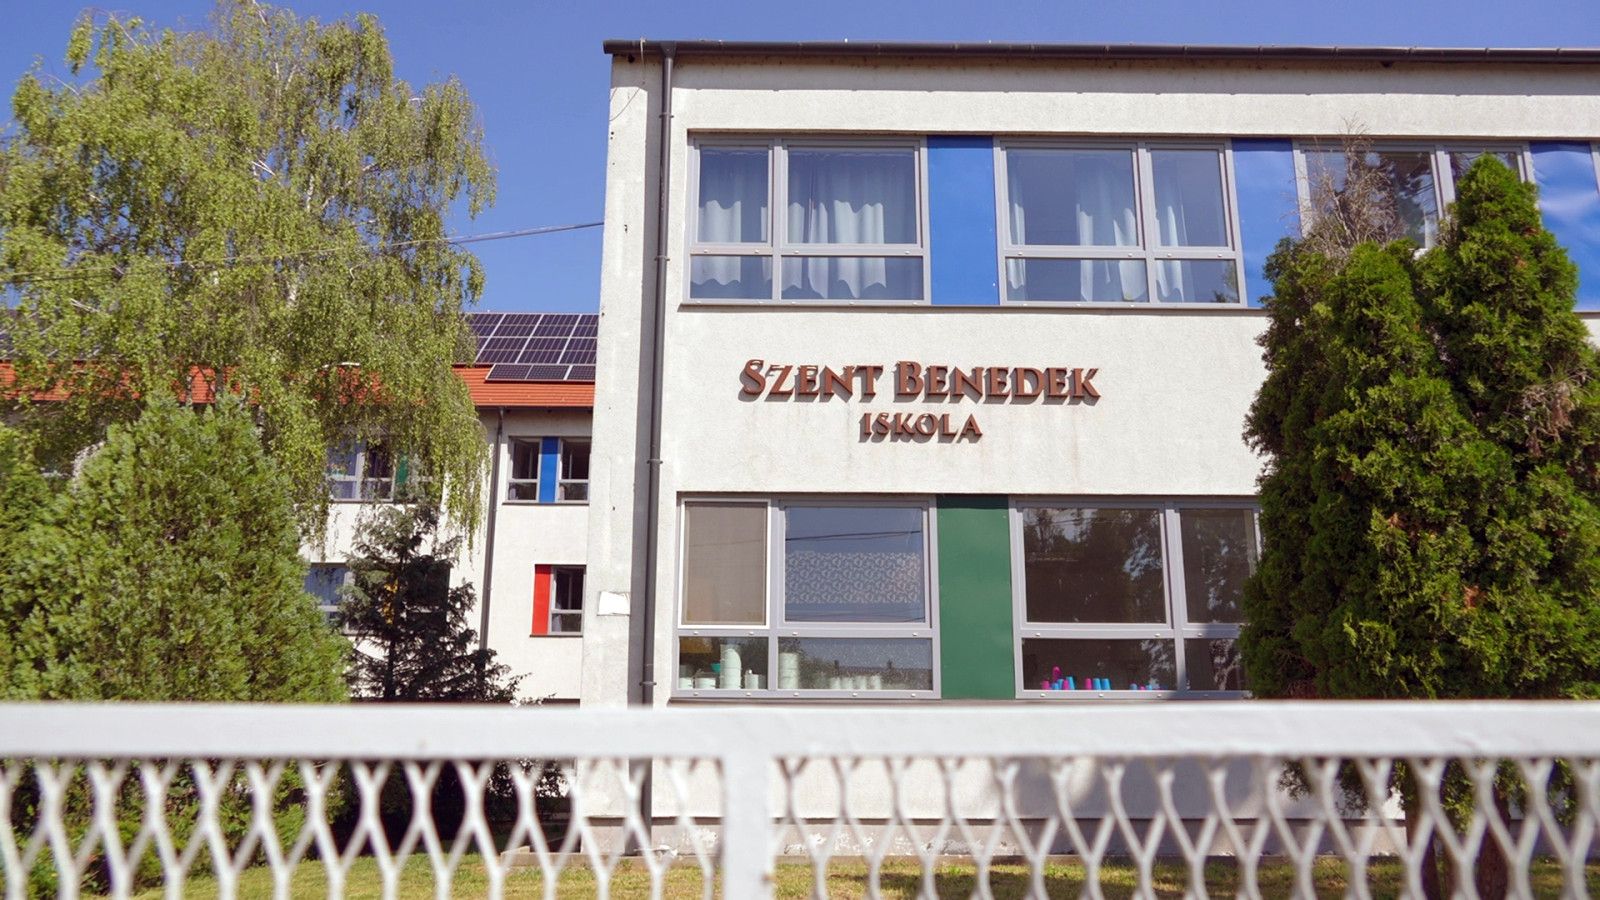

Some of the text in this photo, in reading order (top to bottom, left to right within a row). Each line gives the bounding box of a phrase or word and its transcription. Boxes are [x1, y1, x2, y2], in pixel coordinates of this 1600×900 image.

[740, 359, 1101, 402] SZENT BENEDEK
[861, 412, 983, 439] ISKOLA
